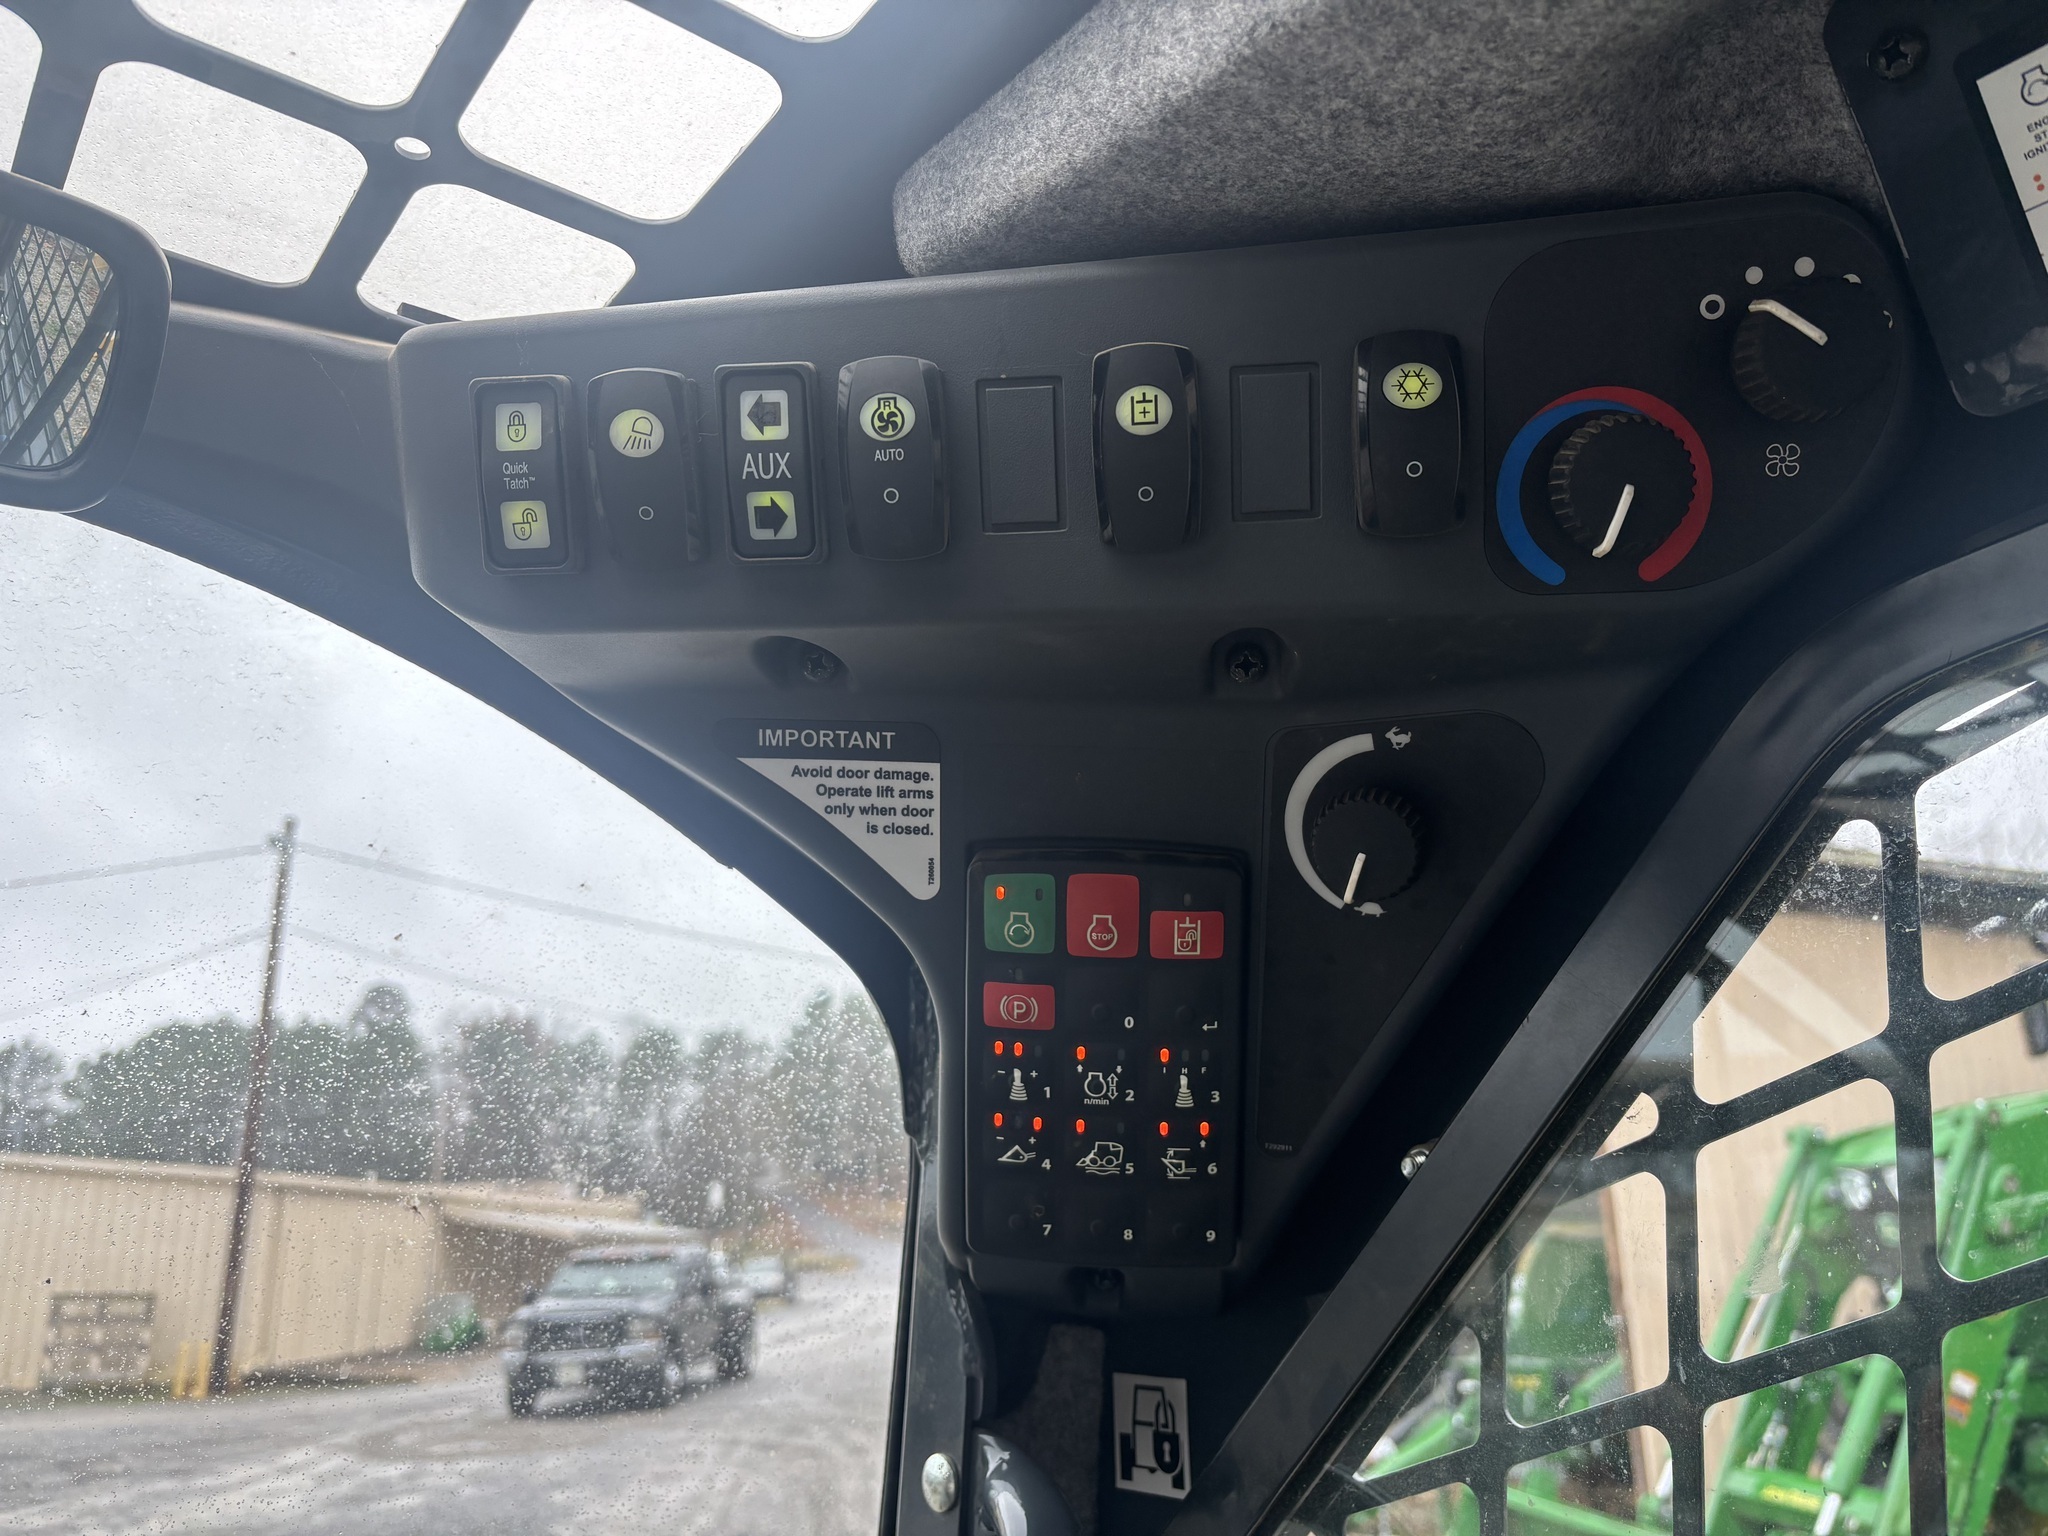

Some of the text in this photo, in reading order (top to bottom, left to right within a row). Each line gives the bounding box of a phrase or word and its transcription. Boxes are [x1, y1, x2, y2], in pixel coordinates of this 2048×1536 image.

[883, 400, 892, 411] R
[874, 448, 904, 462] AUTO
[502, 461, 529, 475] Quick
[742, 452, 792, 480] AUX
[758, 728, 896, 750] IMPORTANT
[791, 764, 935, 784] Avoid door damage.
[816, 783, 934, 800] Operate lift arms
[824, 803, 935, 818] only when door
[866, 821, 934, 836] is closed.
[1091, 932, 1113, 942] STOP
[1013, 1001, 1027, 1019] P
[1124, 1016, 1135, 1029] 0
[1043, 1086, 1051, 1099] 1
[1124, 1090, 1135, 1102] 2
[1210, 1090, 1221, 1103] 3
[1083, 1097, 1110, 1106] n/min
[1041, 1158, 1052, 1171] 4
[1124, 1163, 1135, 1175] 5
[1207, 1163, 1218, 1175] 6
[1042, 1224, 1052, 1236] 7
[1123, 1229, 1134, 1241] 8
[1206, 1230, 1216, 1242] 9
